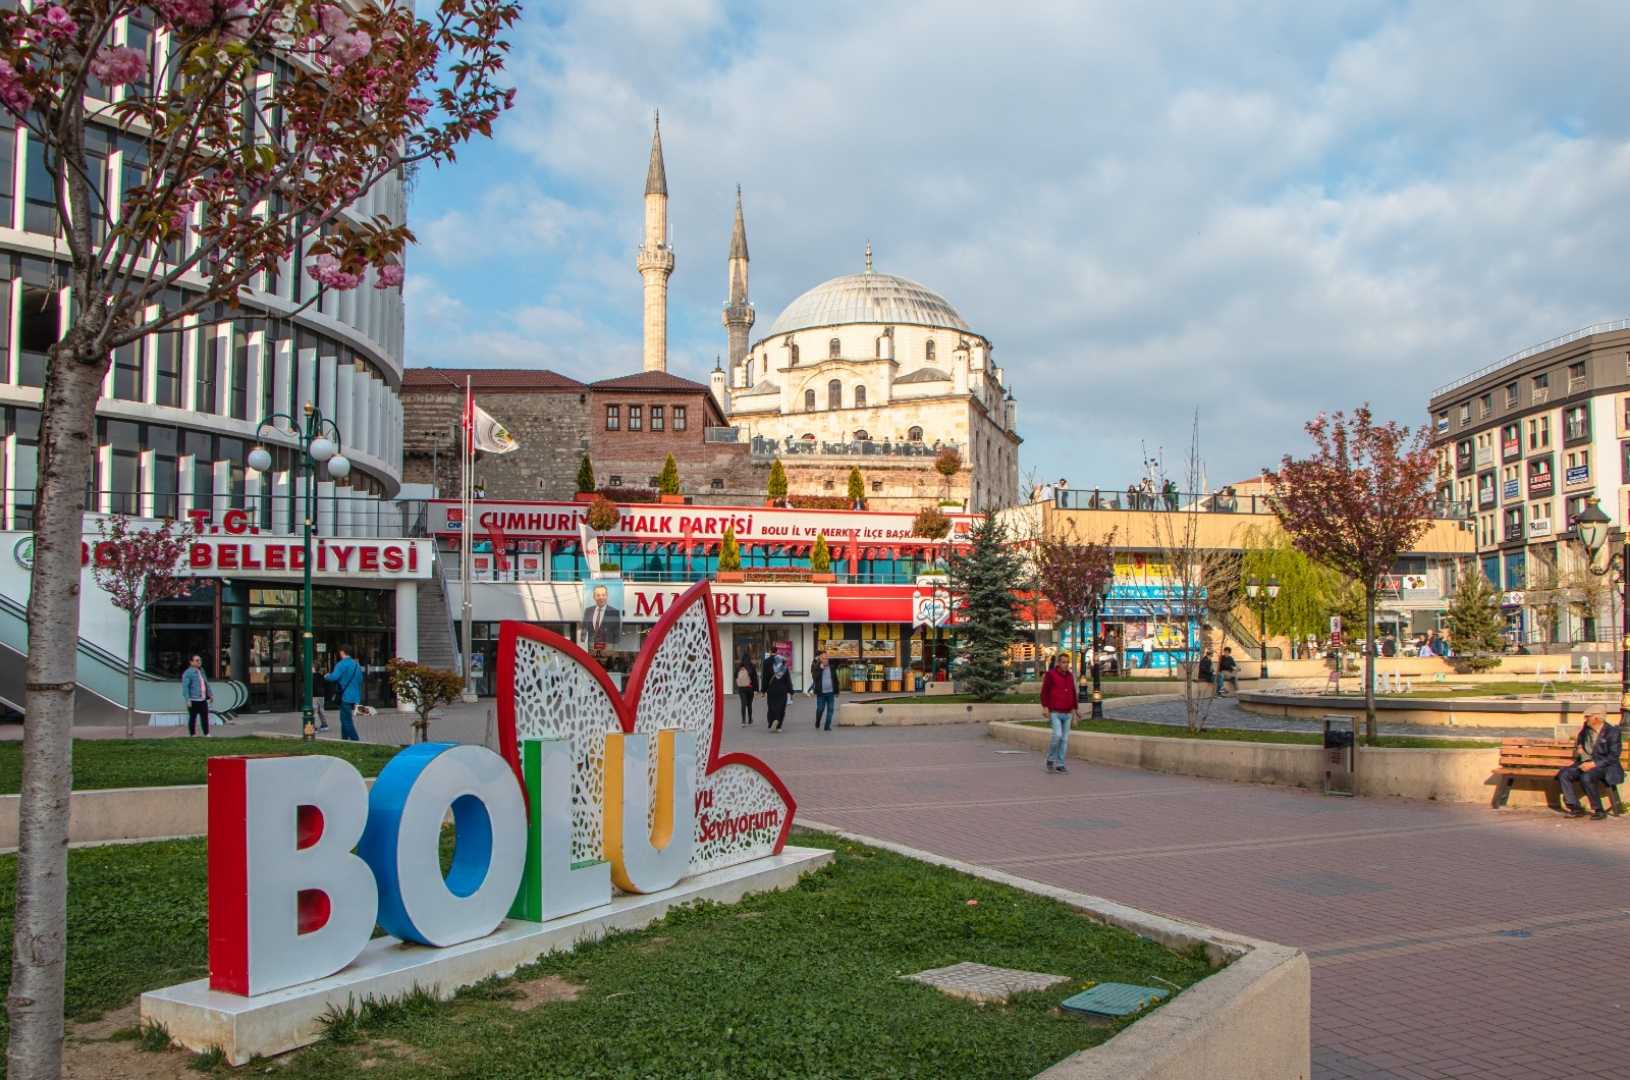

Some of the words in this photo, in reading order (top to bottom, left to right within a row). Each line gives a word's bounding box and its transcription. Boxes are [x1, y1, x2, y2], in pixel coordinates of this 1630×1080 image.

[187, 508, 259, 535] T.C.
[621, 514, 672, 533] HALK
[679, 514, 753, 535] PARTİSİ
[761, 526, 788, 537] BOLU
[792, 524, 801, 537] İL
[804, 527, 818, 537] VE
[821, 527, 862, 537] MERKZ
[863, 525, 883, 540] İLÇE
[189, 539, 418, 573] BELEDİYESİ
[694, 789, 713, 818] yu
[699, 809, 778, 844] Seviyorum
[209, 730, 697, 998] BOLU
